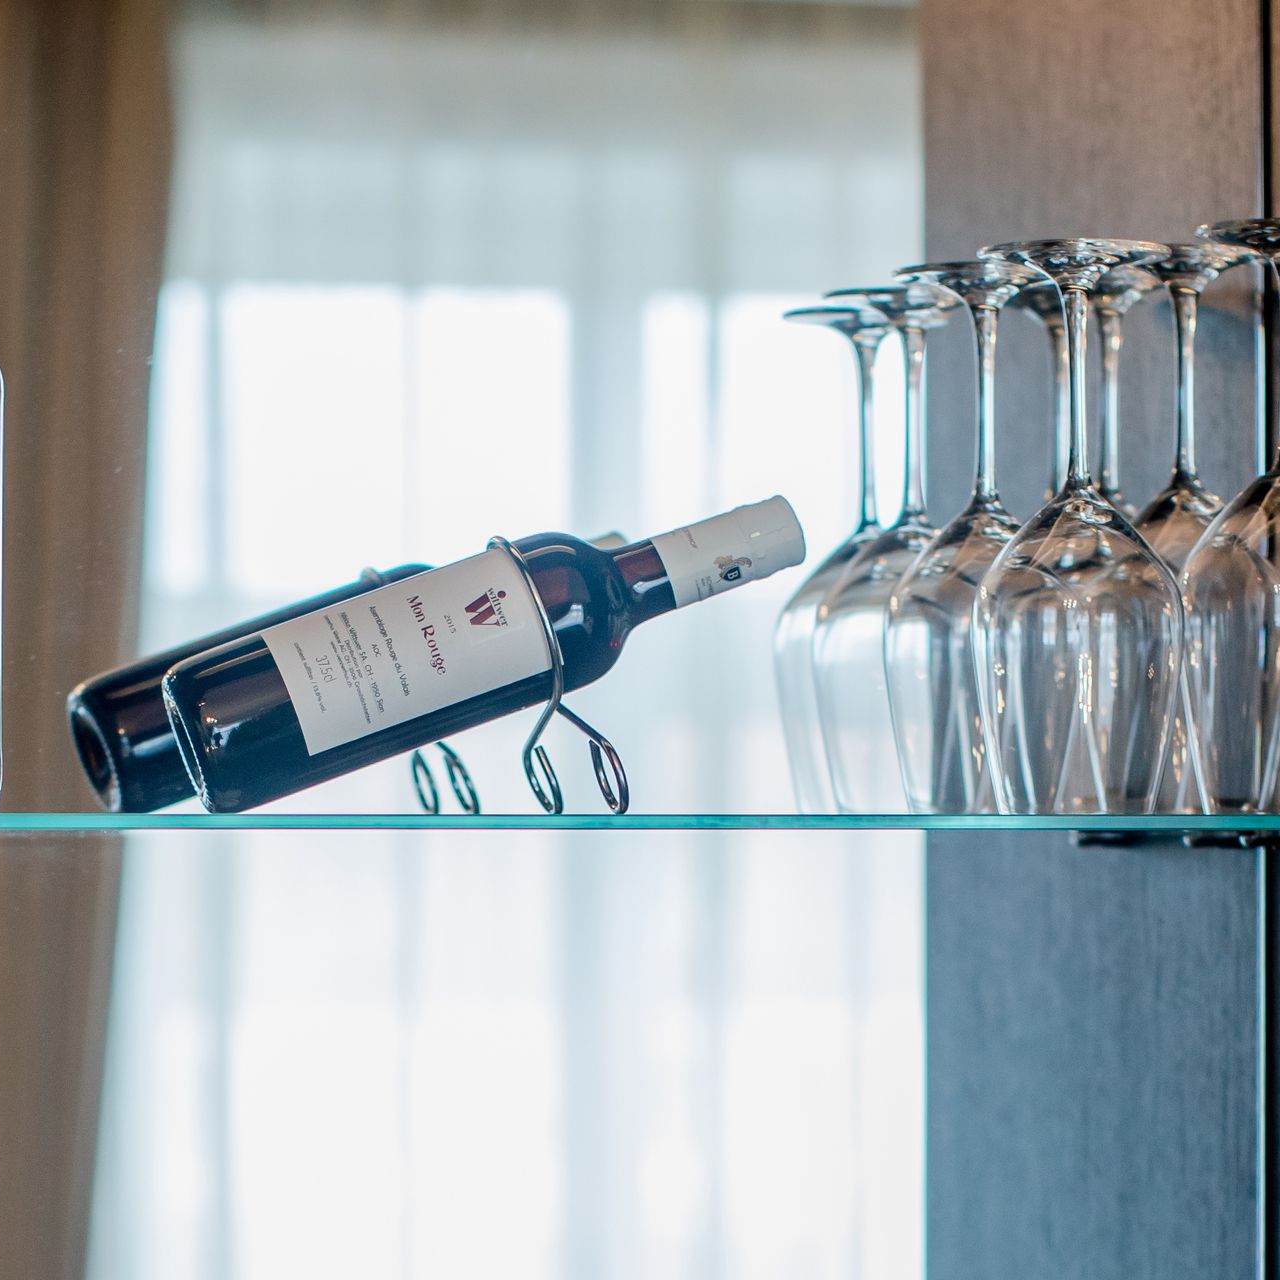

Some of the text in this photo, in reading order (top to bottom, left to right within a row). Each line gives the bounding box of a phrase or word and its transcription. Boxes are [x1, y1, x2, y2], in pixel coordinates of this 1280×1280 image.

[726, 570, 739, 580] B
[487, 587, 508, 626] wittwer
[443, 614, 456, 633] 2015
[405, 595, 446, 675] Mon Rouge
[371, 643, 381, 657] AOC
[384, 637, 397, 661] Rouge
[394, 662, 402, 673] du
[376, 698, 384, 713] Sion
